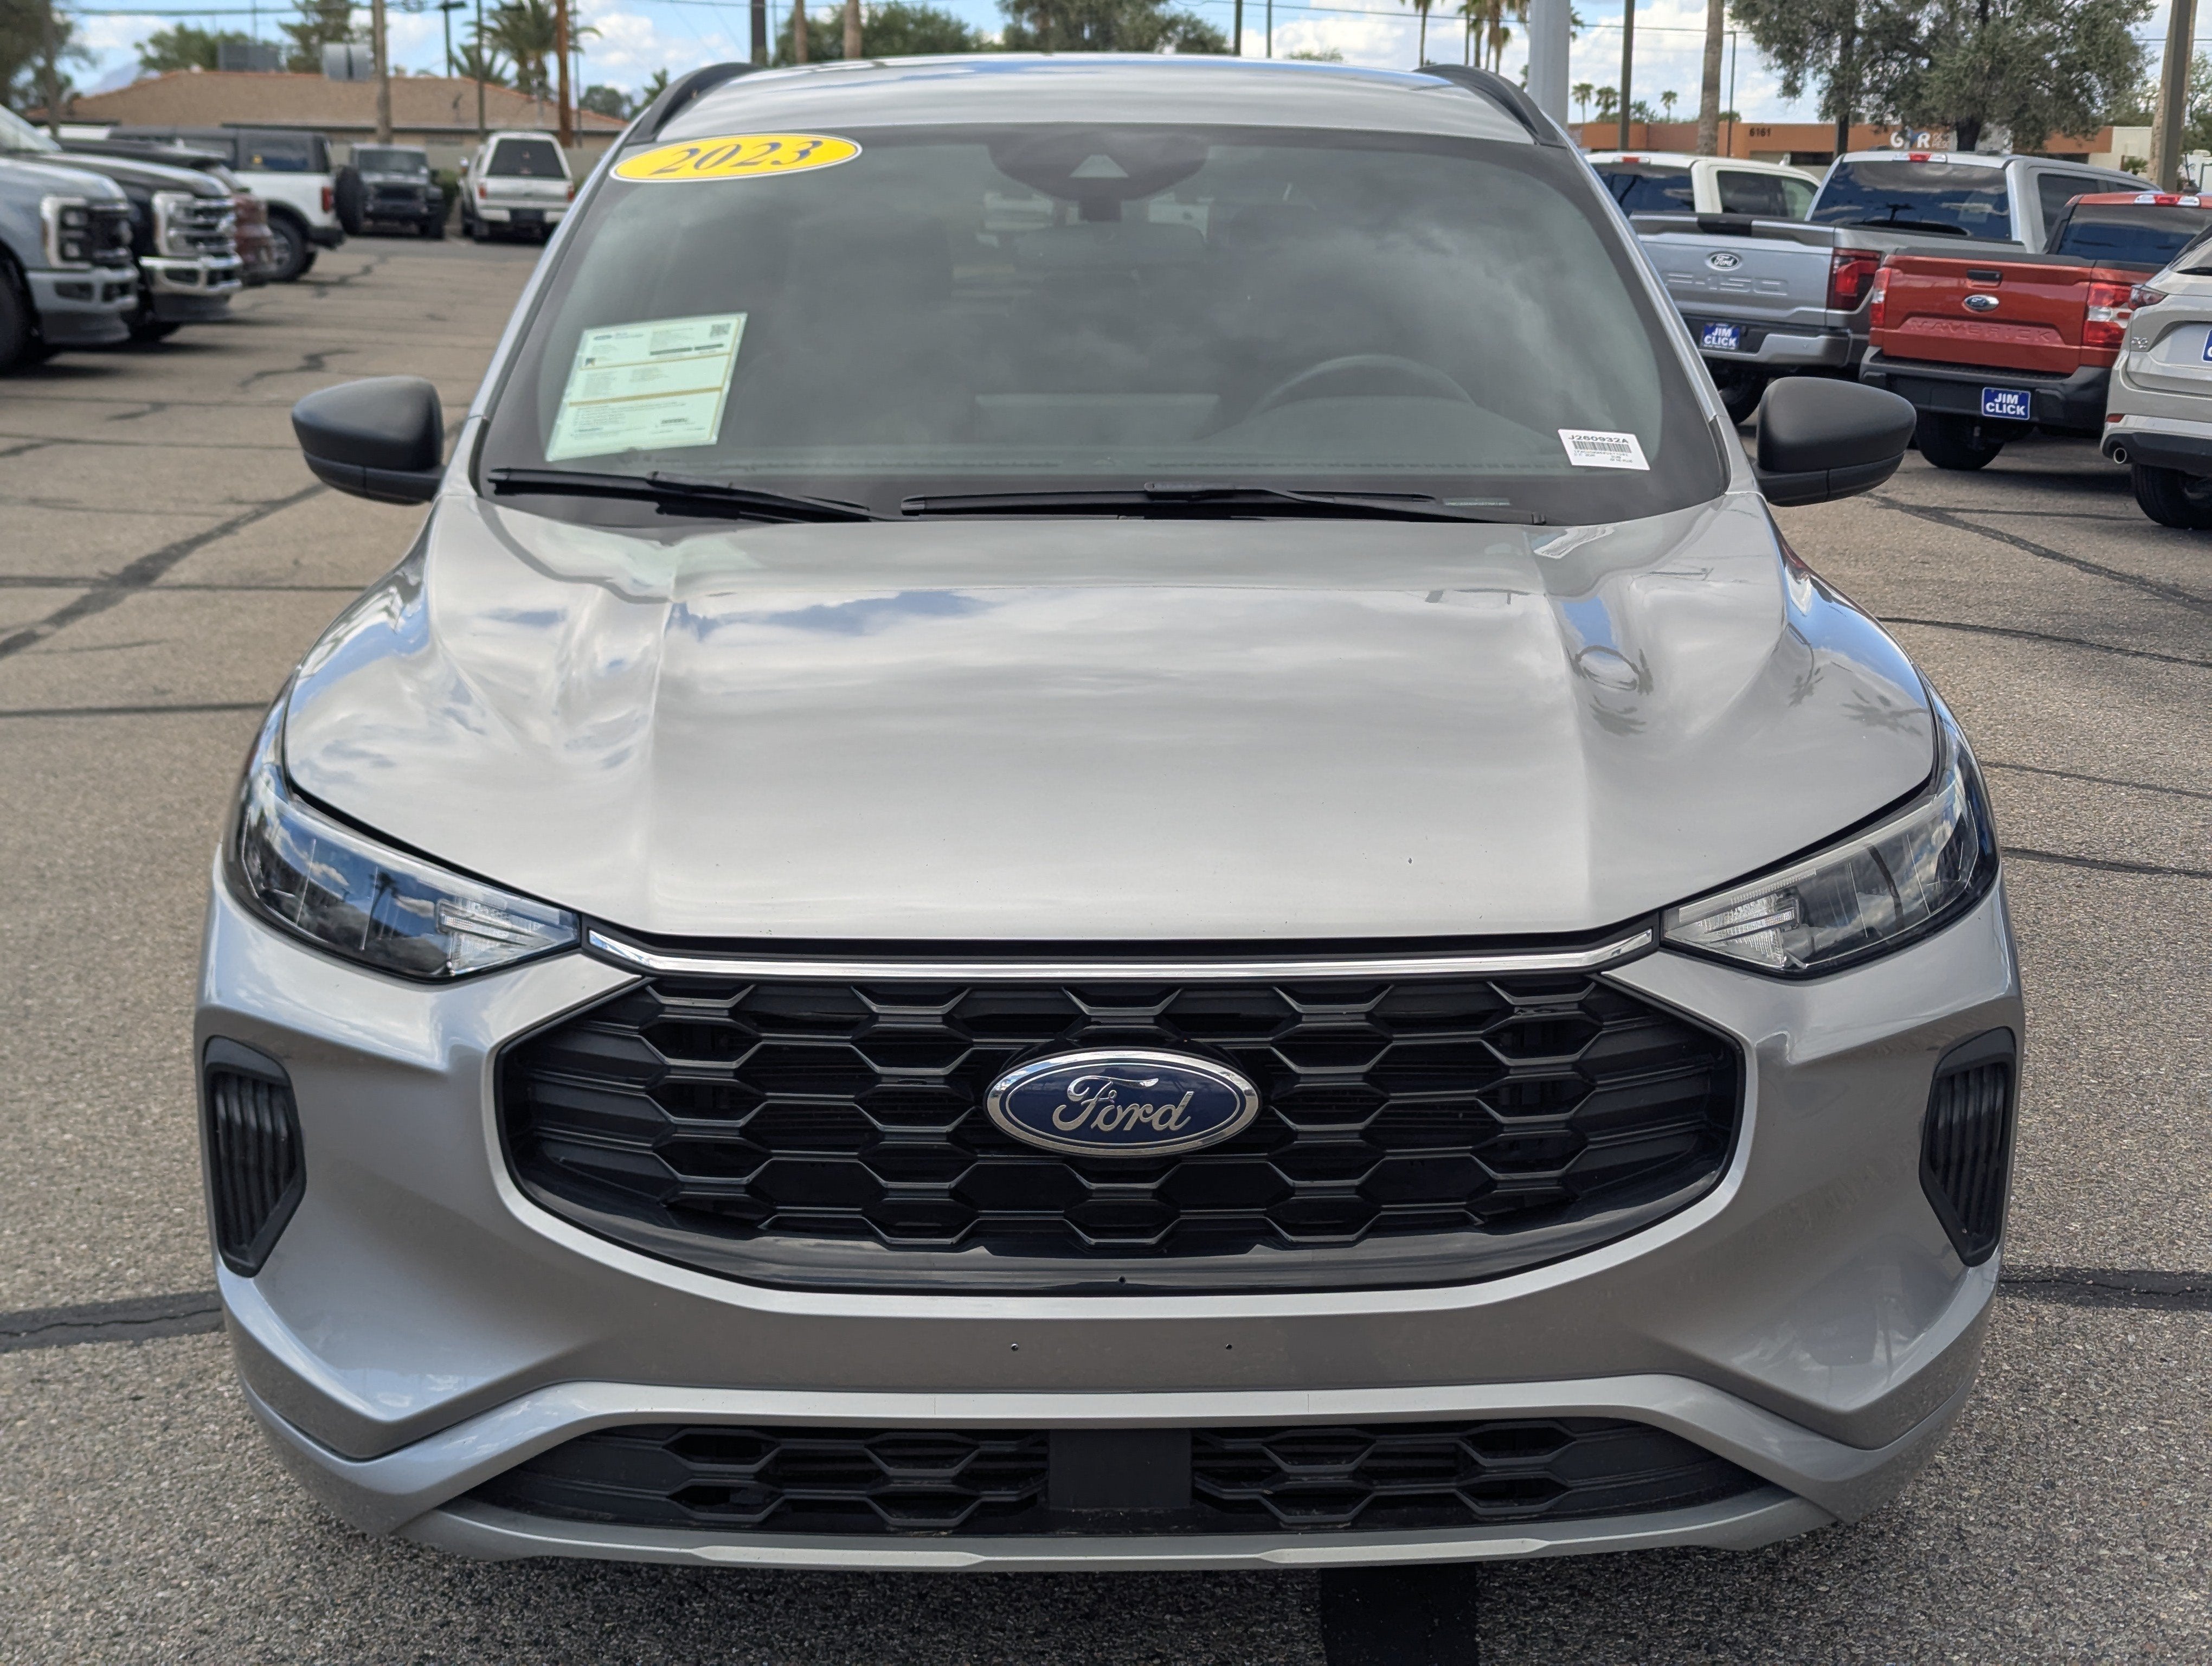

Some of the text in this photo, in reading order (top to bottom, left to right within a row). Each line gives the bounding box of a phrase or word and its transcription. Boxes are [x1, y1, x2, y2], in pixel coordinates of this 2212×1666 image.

[648, 139, 824, 176] 2023
[1713, 254, 1735, 266] Ford
[1712, 327, 1732, 337] JIM
[1703, 335, 1738, 347] CLICK
[1994, 393, 2018, 405] JIM
[1985, 402, 2025, 416] CLICK
[1052, 1075, 1194, 1131] Ford
